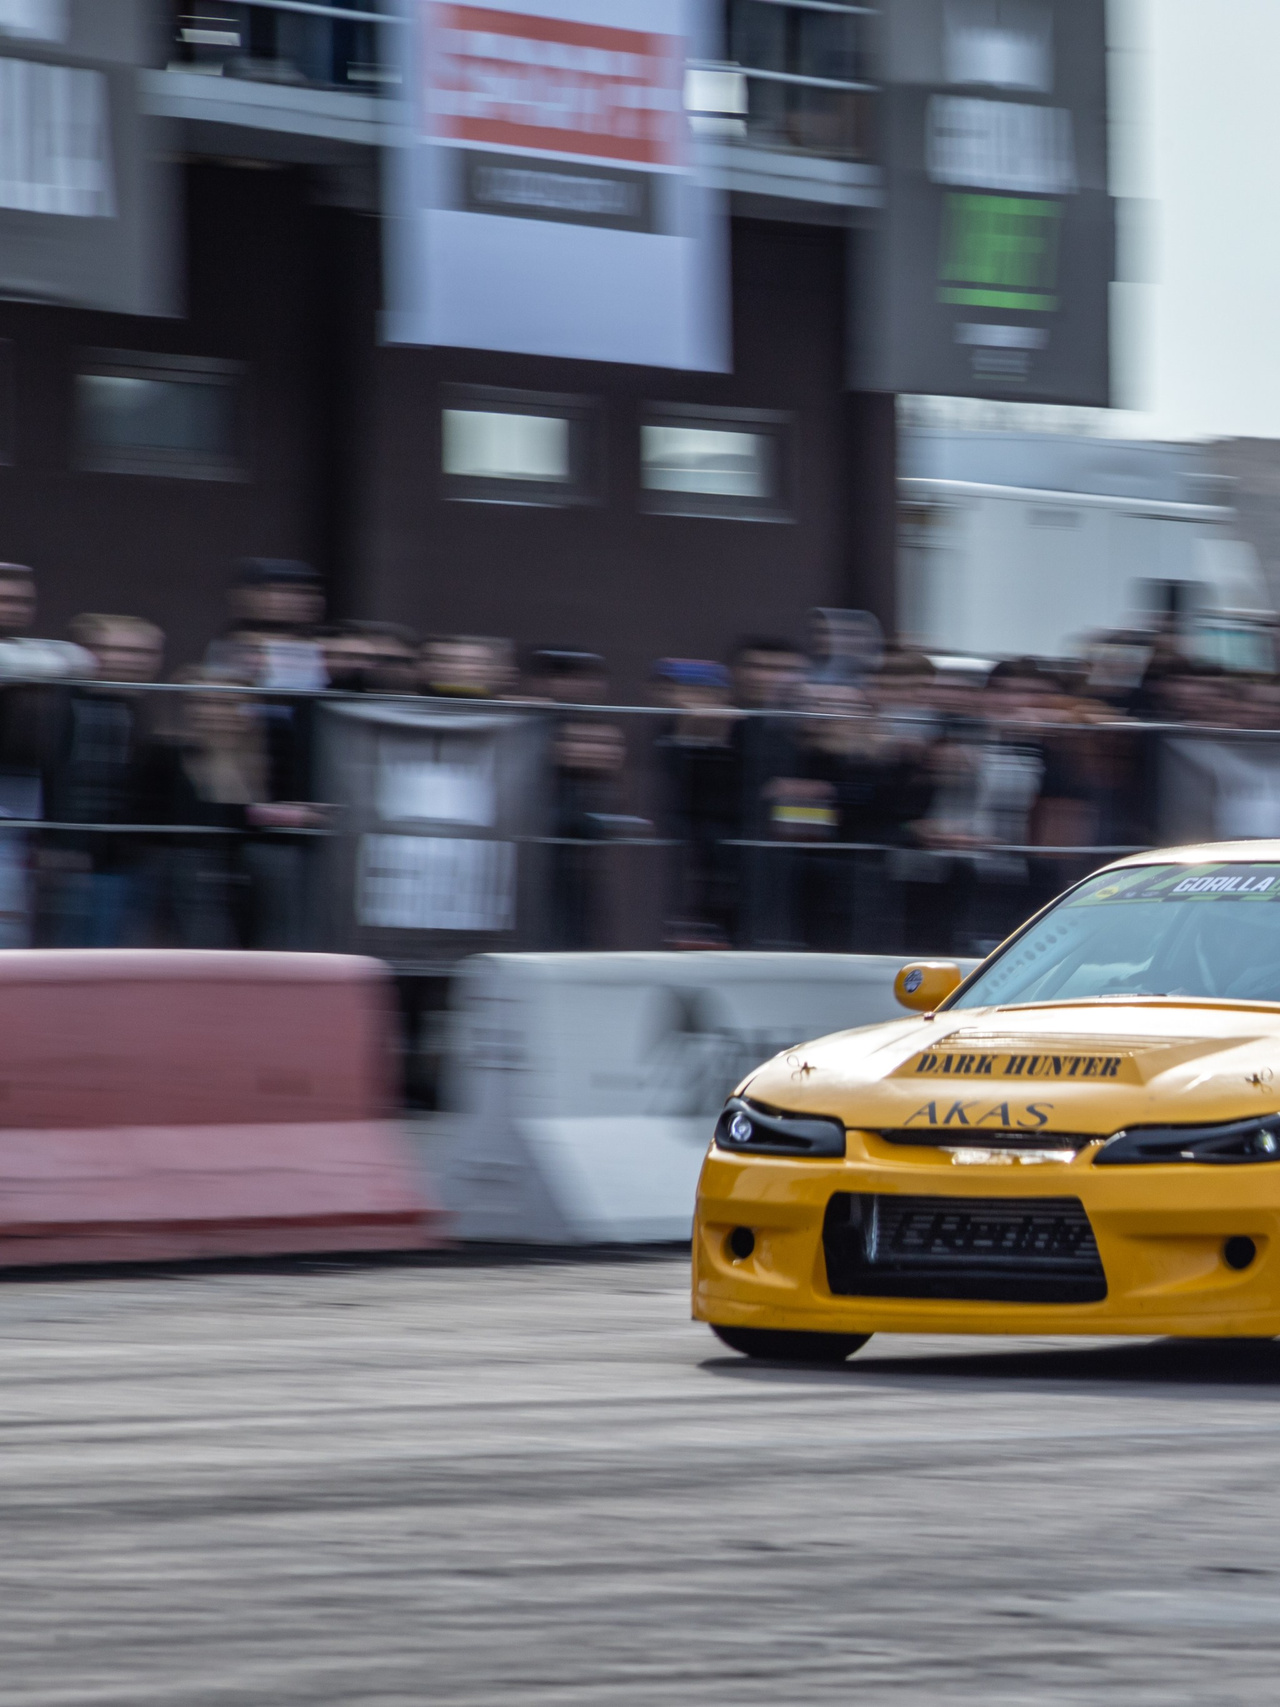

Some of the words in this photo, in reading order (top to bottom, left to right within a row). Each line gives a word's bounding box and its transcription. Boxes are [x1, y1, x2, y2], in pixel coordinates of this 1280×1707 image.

[914, 1053, 999, 1075] DARK
[1003, 1054, 1122, 1077] HUNTER
[903, 1099, 1055, 1128] AKAS
